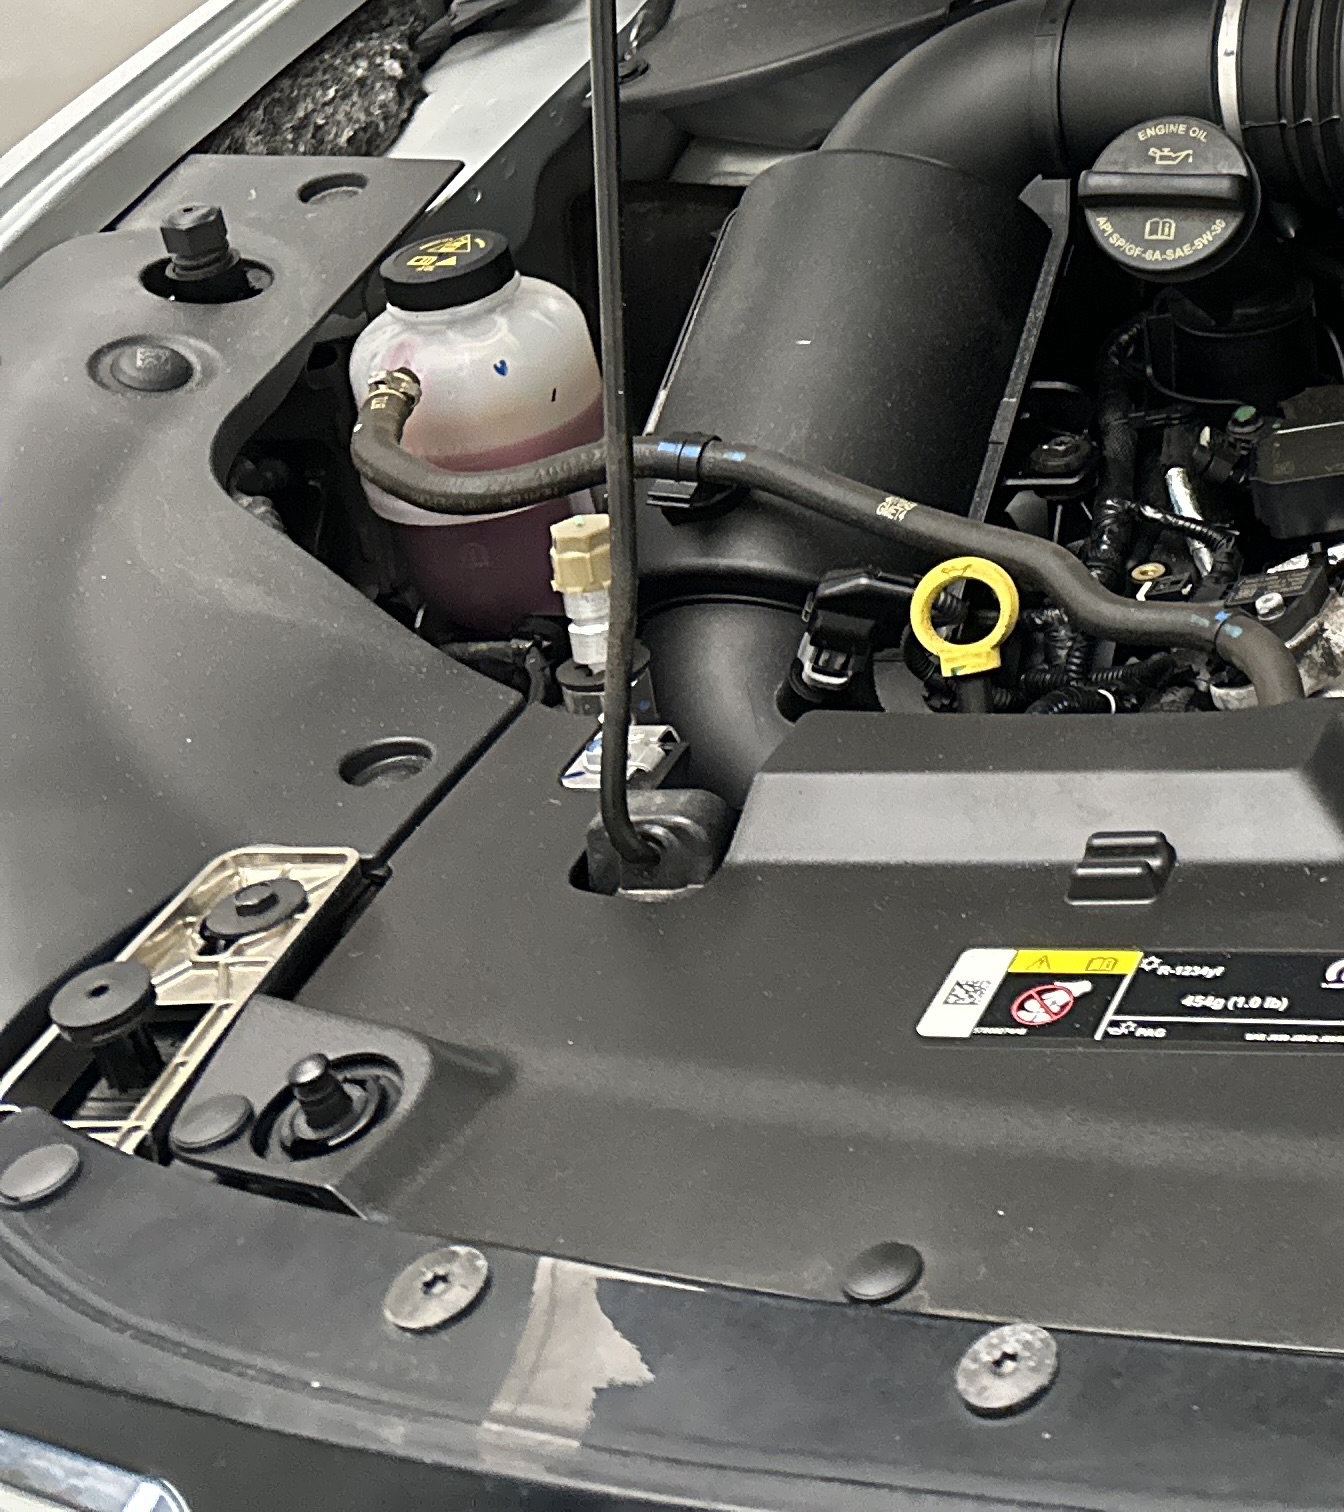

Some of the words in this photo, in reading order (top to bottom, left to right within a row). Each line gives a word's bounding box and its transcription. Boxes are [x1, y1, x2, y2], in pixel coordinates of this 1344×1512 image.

[1137, 123, 1187, 141] ENGINE
[1189, 126, 1208, 143] OIL
[1096, 216, 1115, 237] API
[1156, 965, 1225, 979] R-1234yf
[1181, 995, 1225, 1010] 454g
[1227, 995, 1262, 1010] (1.0
[1263, 995, 1289, 1012] lb)
